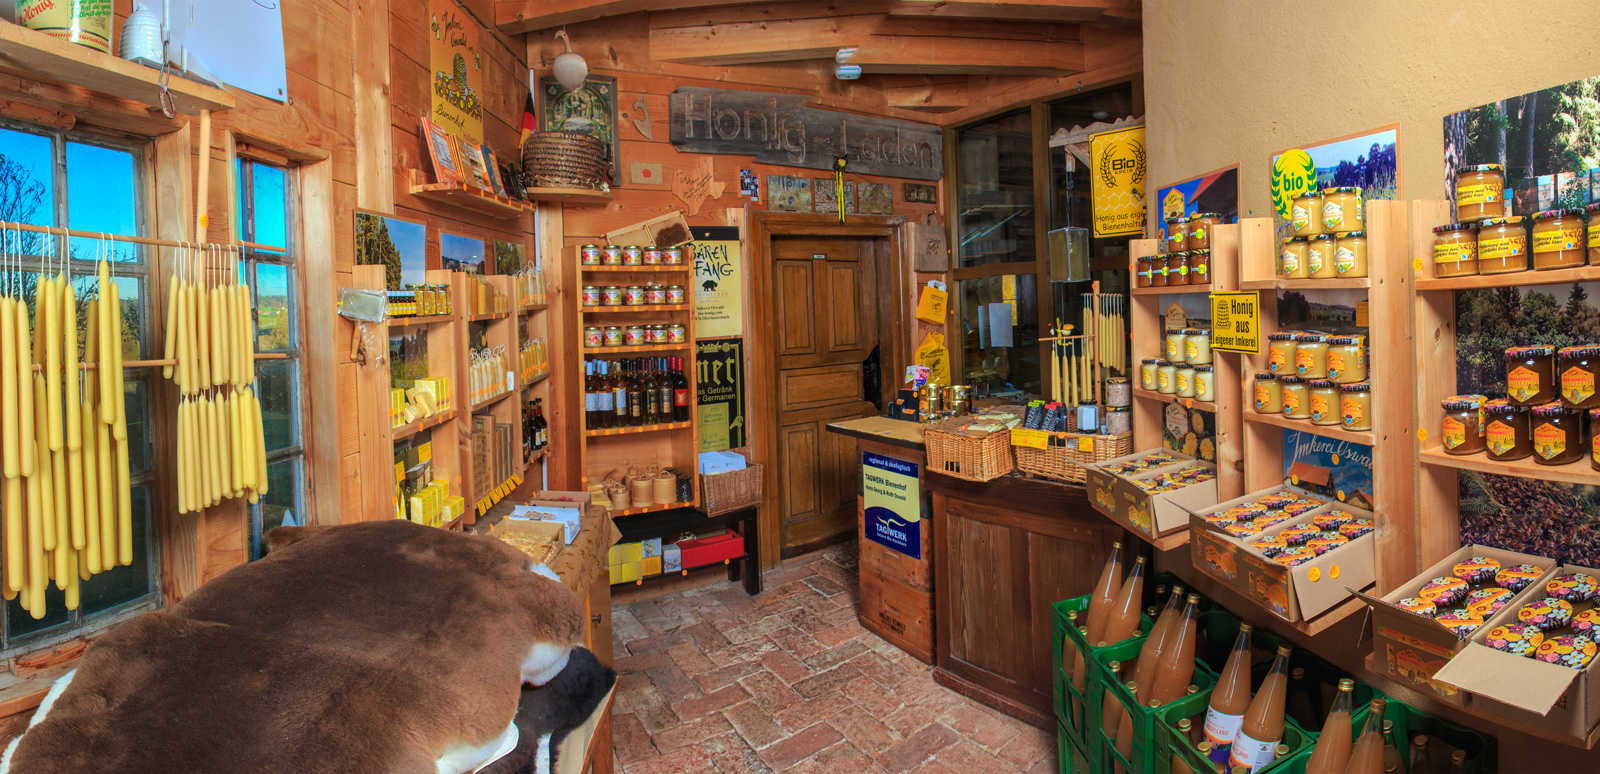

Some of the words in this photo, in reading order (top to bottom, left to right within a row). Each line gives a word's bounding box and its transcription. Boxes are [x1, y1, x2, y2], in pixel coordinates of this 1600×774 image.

[684, 92, 806, 164] Honig
[1112, 158, 1136, 171] Bio
[1283, 171, 1304, 191] bio
[694, 260, 734, 280] FANG
[1231, 298, 1254, 319] Honig
[1235, 320, 1250, 333] aus
[1215, 336, 1234, 347] eigener
[1235, 336, 1257, 348] Imkerei
[703, 393, 736, 402] Germanen
[865, 473, 885, 486] TAGWERK
[876, 521, 908, 542] TAGWERK
